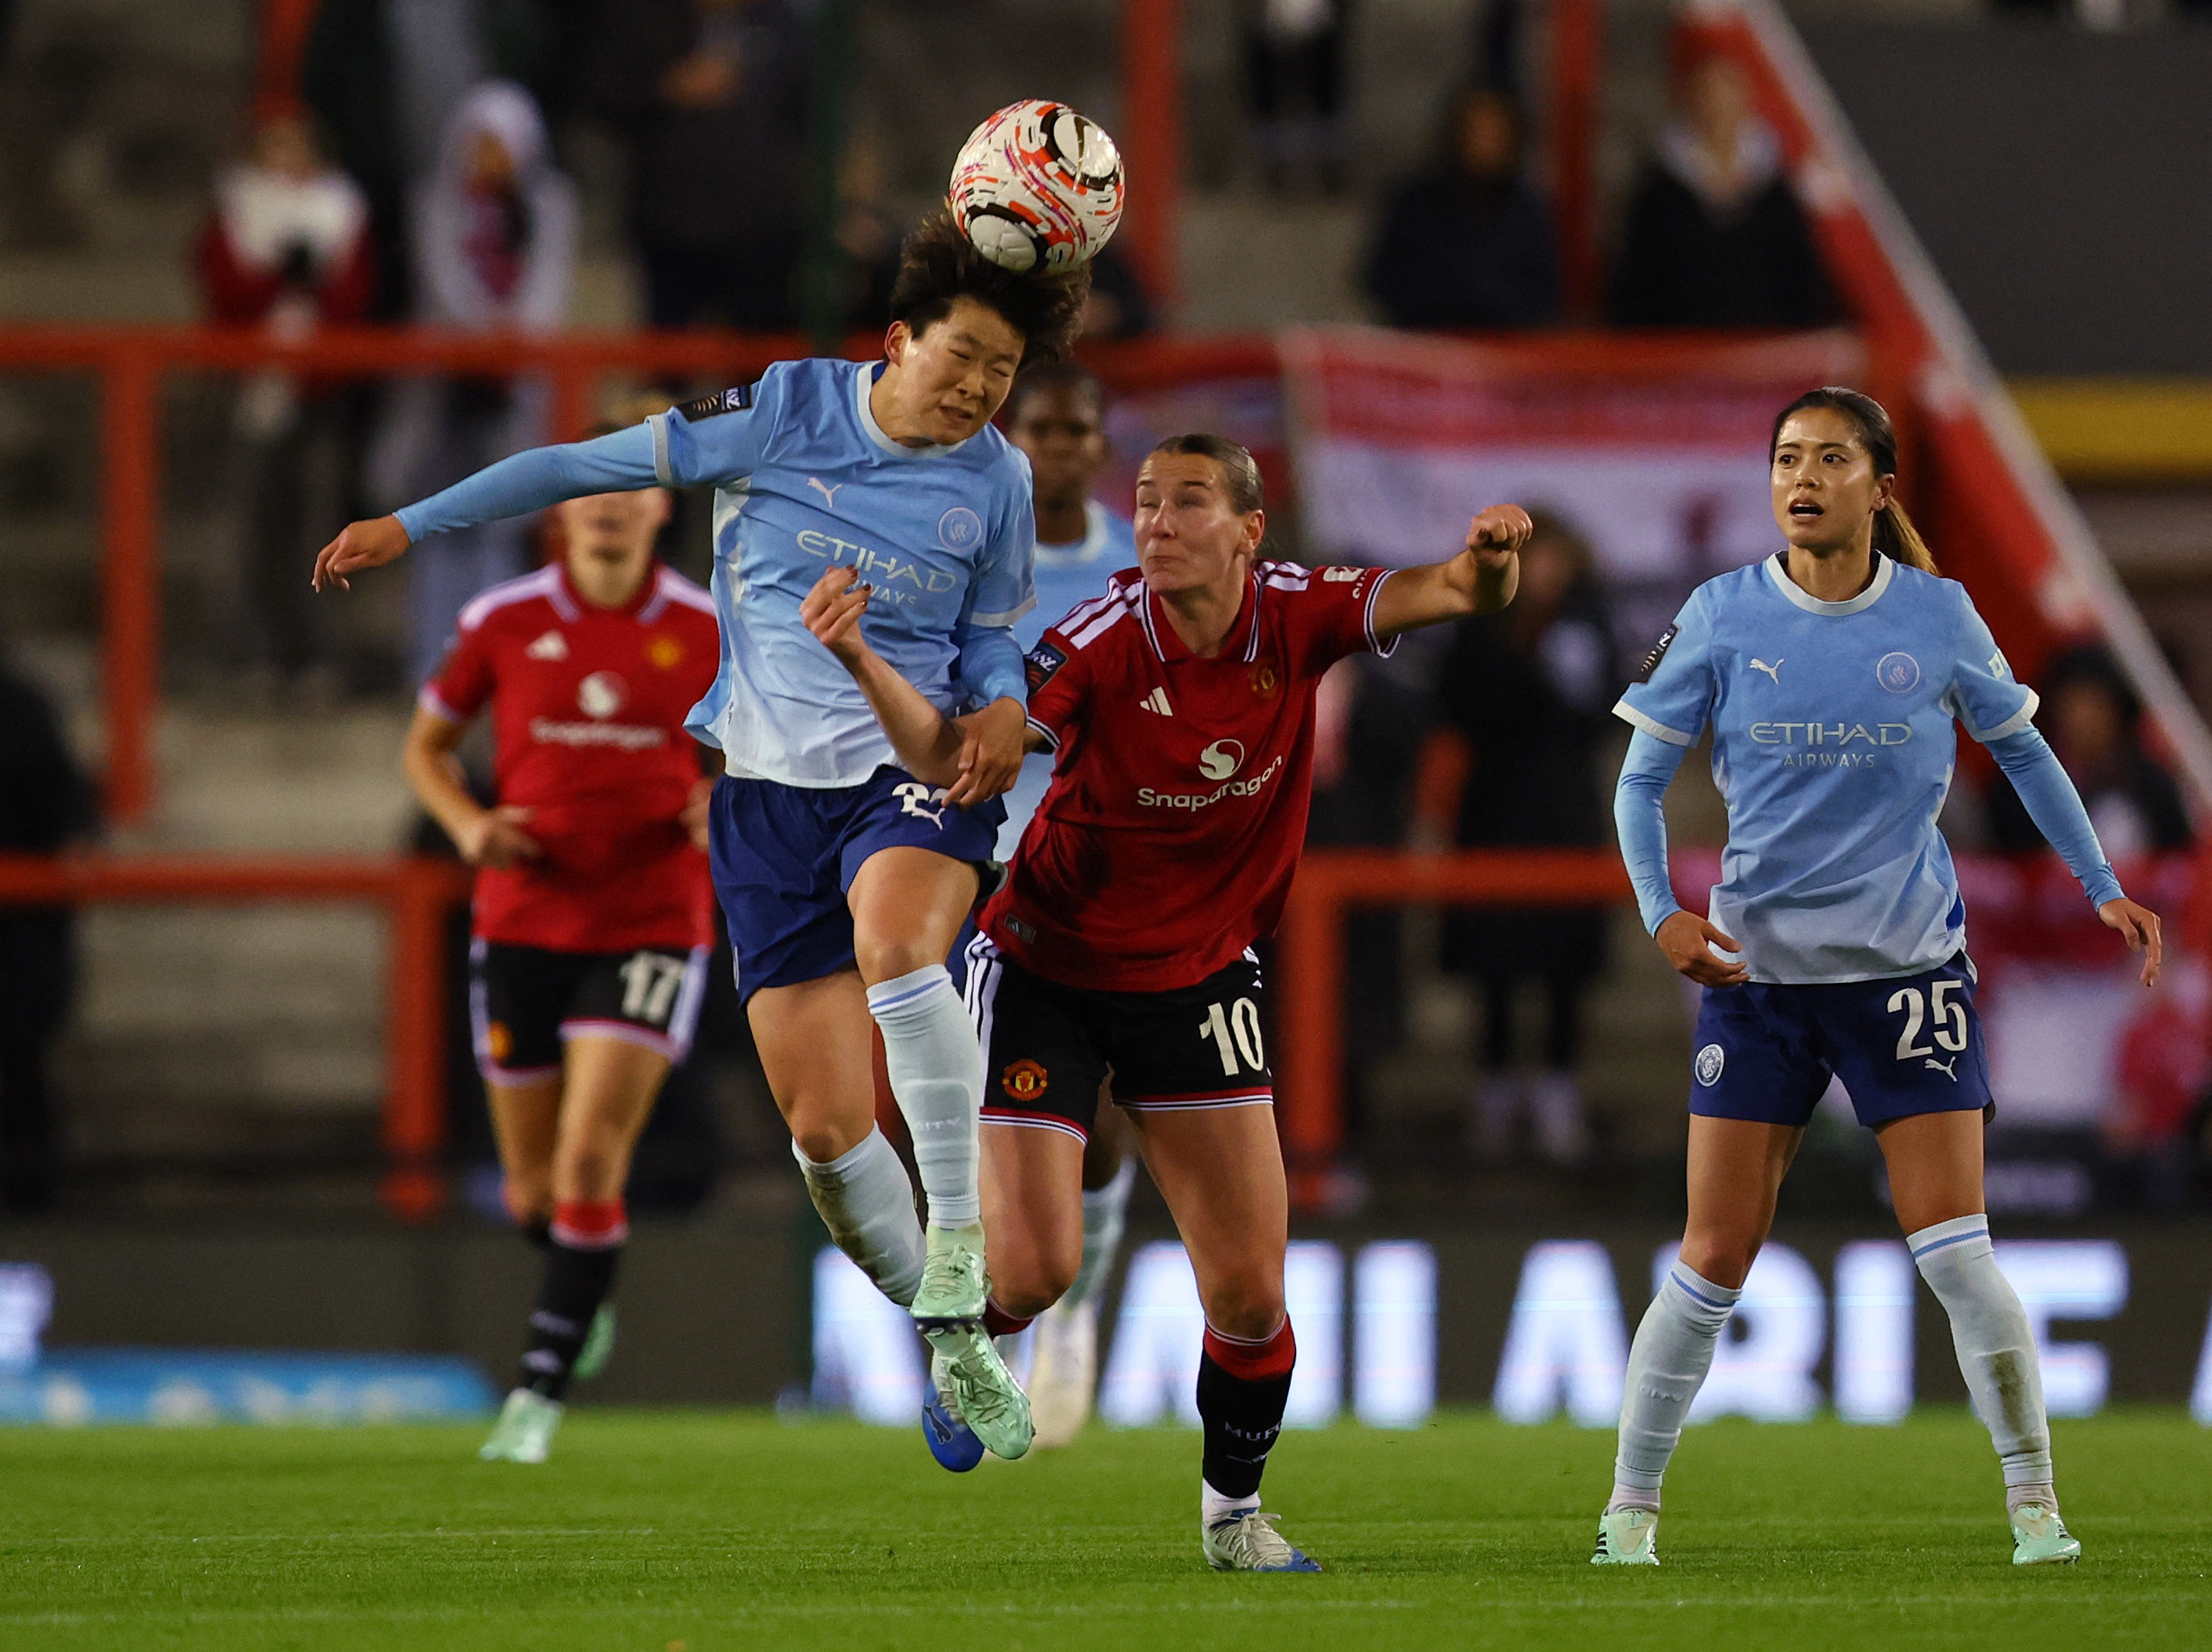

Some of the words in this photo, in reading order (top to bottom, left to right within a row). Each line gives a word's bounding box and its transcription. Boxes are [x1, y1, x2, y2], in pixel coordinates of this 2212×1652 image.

[797, 530, 956, 593] ETIHAD
[1749, 722, 1912, 746] ETIHAD
[1783, 753, 1876, 768] AIRWAYS
[1137, 755, 1282, 812] Snapdragon
[620, 949, 687, 1021] 17
[1199, 997, 1264, 1076] 10
[1887, 980, 1968, 1061] 25
